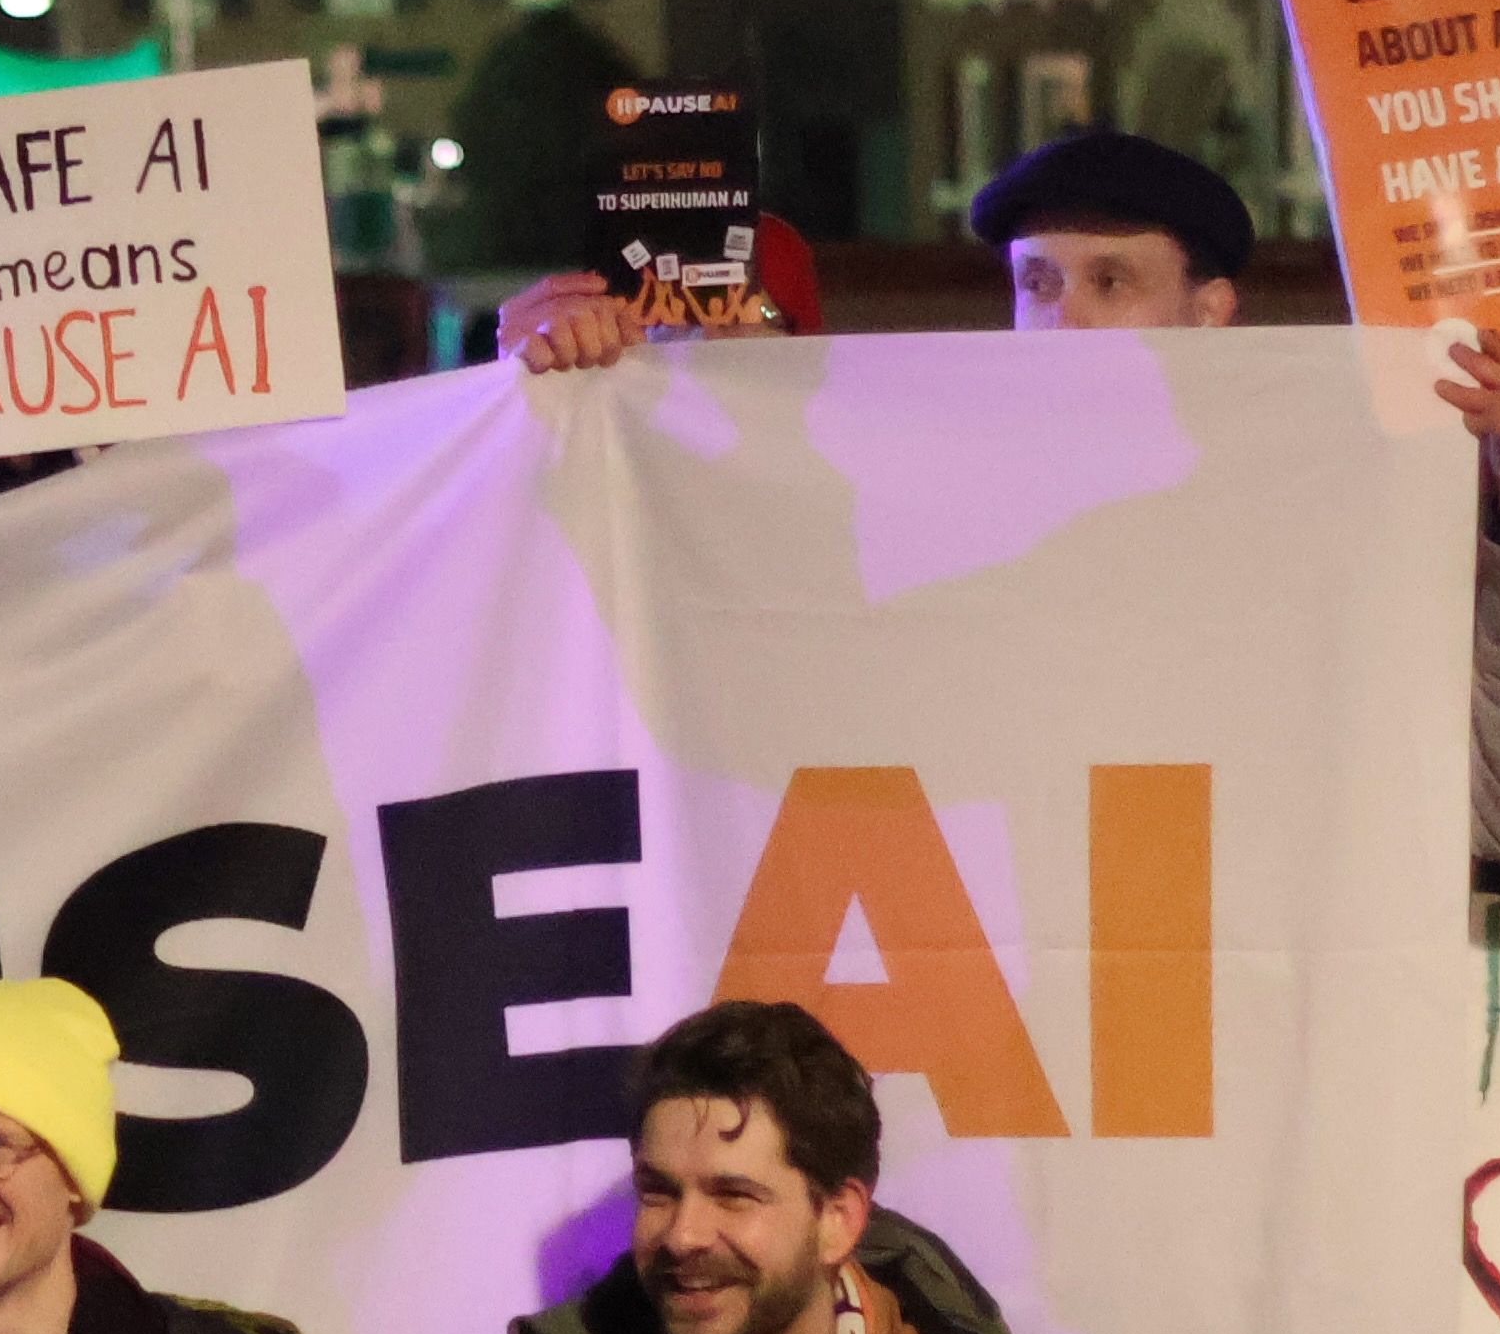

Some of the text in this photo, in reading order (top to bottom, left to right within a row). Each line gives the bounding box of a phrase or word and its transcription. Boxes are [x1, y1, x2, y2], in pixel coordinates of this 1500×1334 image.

[1356, 13, 1478, 68] ABOUT
[1367, 85, 1446, 135] YOU
[135, 118, 210, 195] AI
[1381, 147, 1485, 203] HAVE
[597, 190, 748, 211] TO SUPERHUMAN AI
[177, 285, 272, 401] AI
